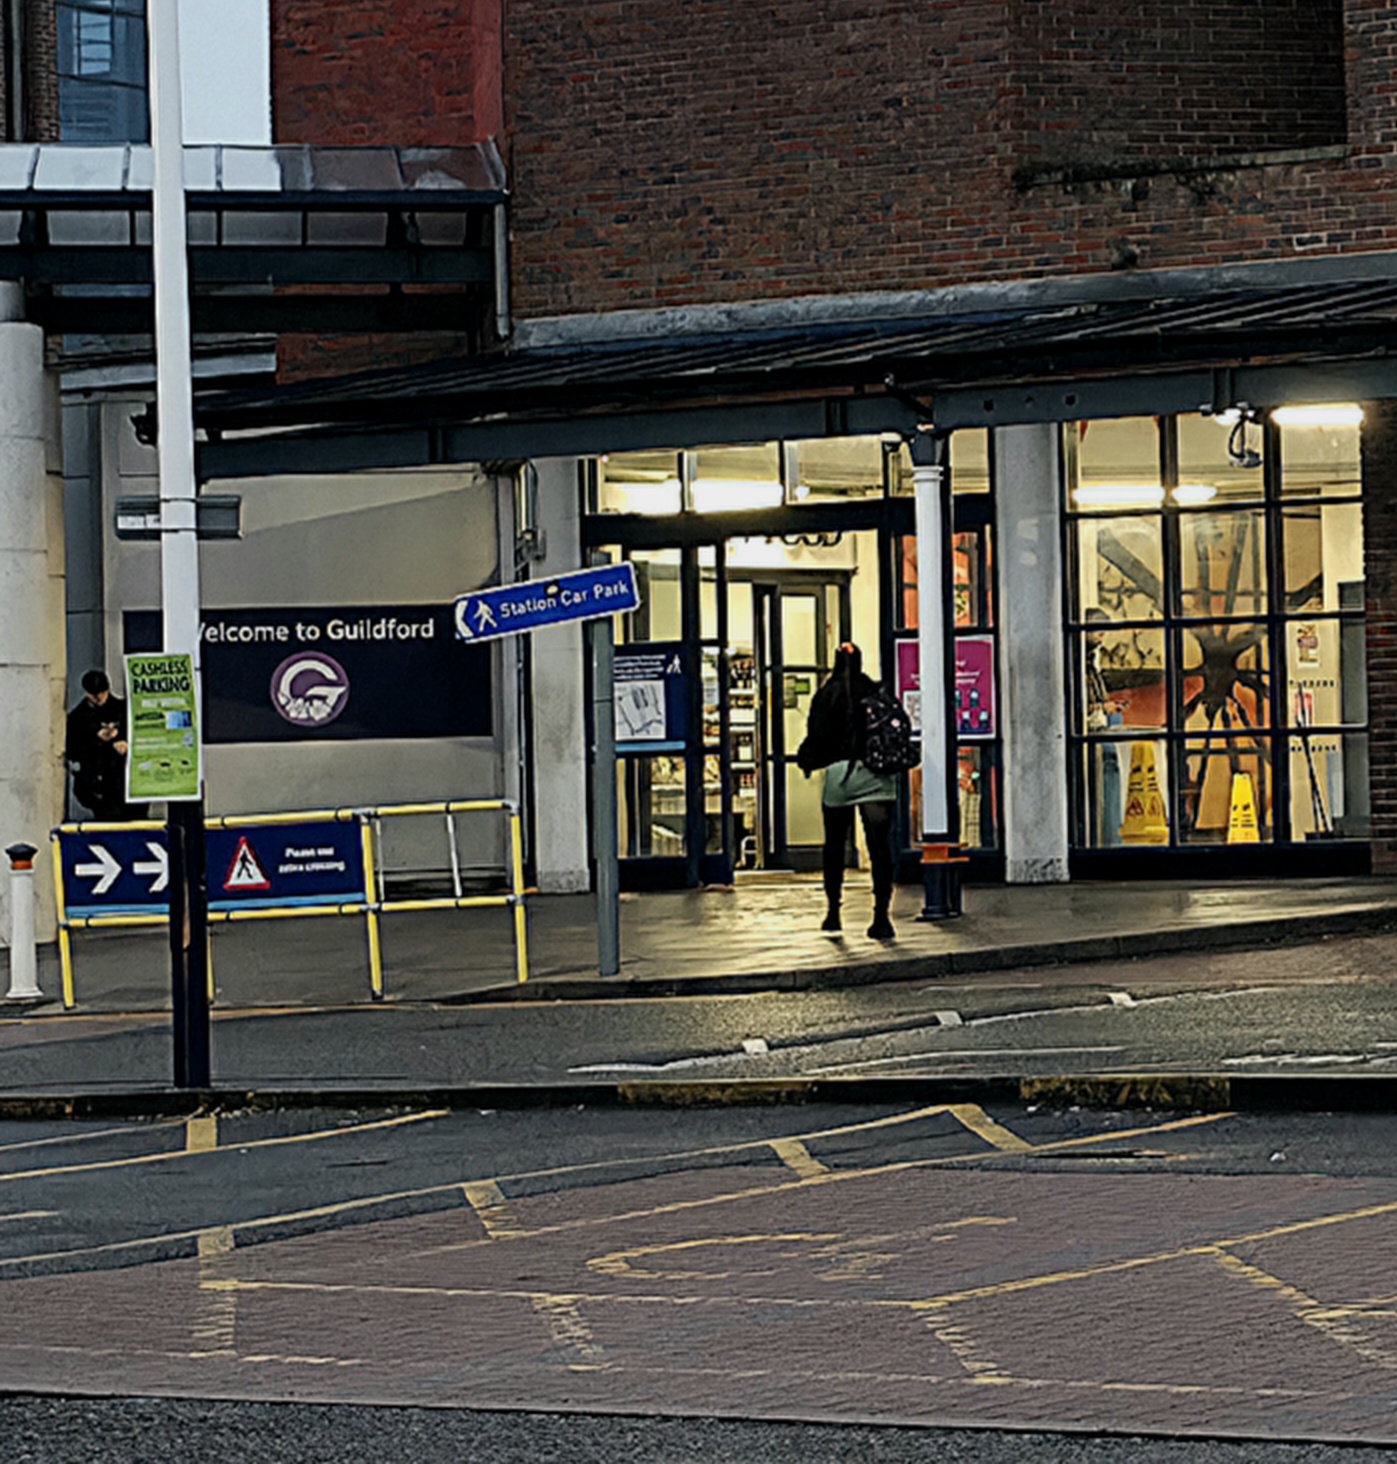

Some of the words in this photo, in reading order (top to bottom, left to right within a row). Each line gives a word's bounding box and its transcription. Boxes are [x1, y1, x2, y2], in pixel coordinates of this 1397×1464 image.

[500, 596, 557, 619] Station
[560, 588, 588, 606] Car
[593, 579, 629, 600] Park
[295, 622, 321, 642] to
[326, 617, 435, 641] Guildford
[131, 659, 188, 677] CASHLESS
[133, 676, 191, 694] PARKING
